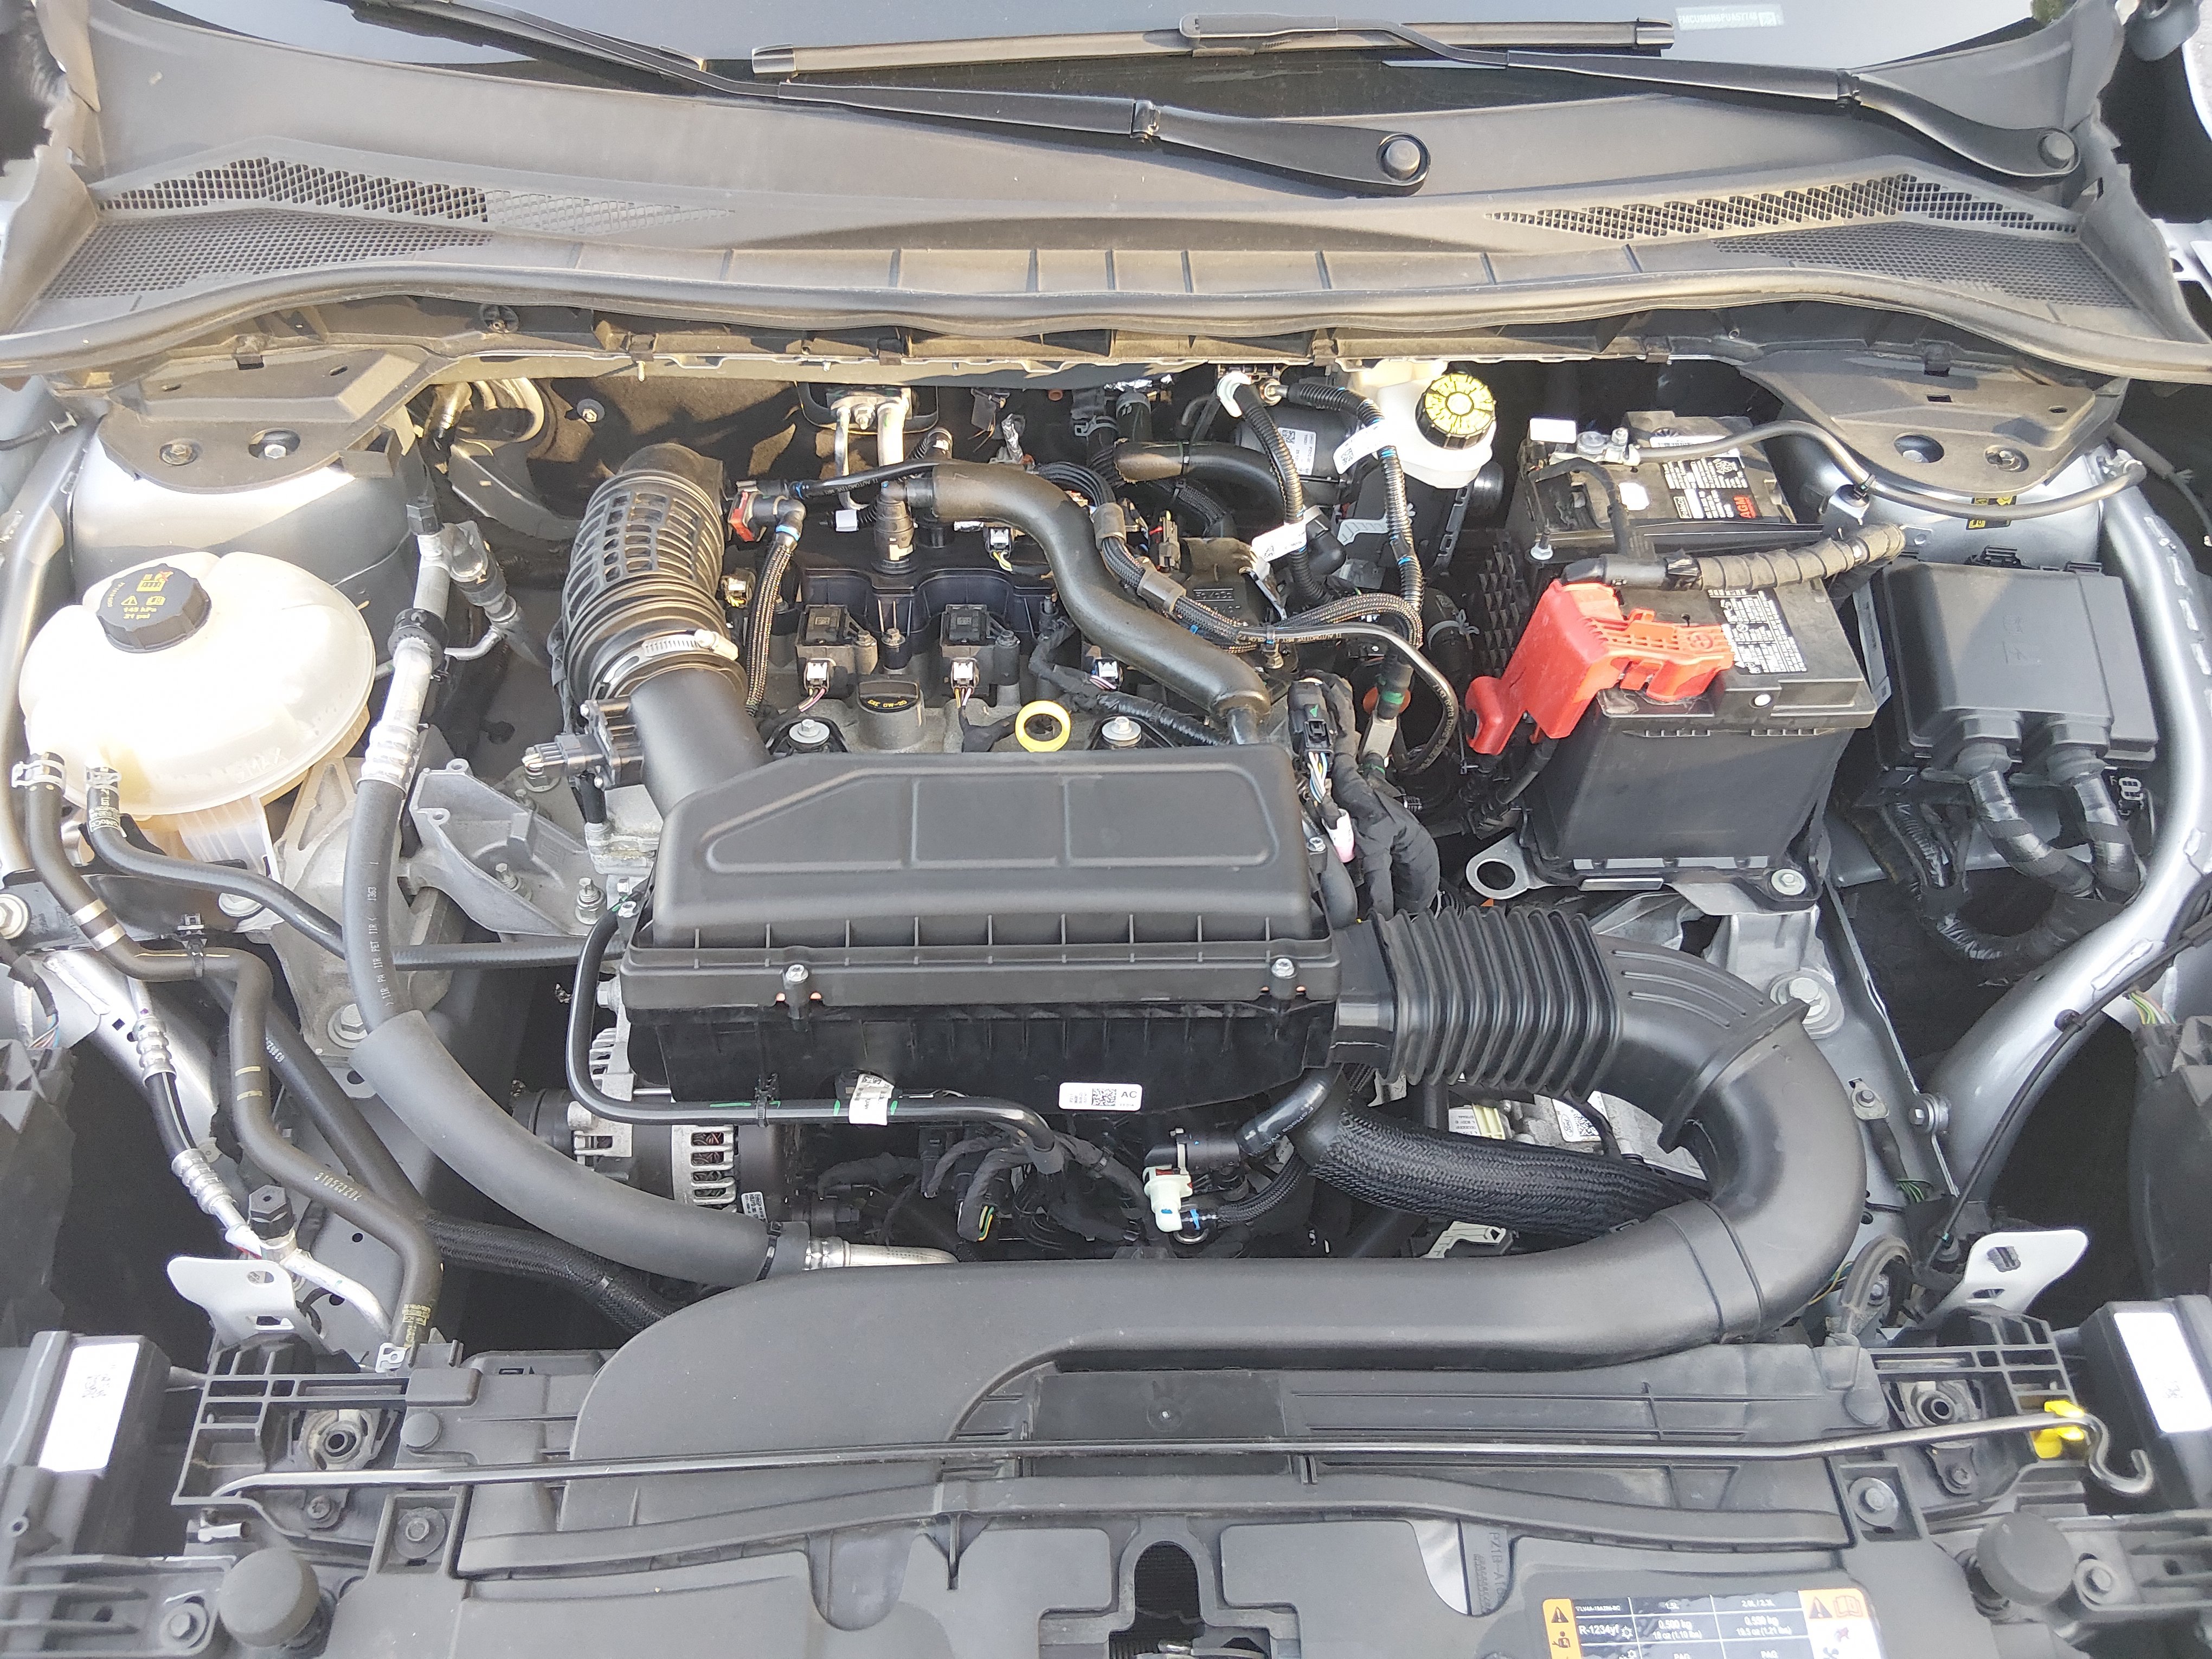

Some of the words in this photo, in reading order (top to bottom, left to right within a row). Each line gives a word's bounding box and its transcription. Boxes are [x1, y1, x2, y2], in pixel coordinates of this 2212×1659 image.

[1733, 496, 1750, 518] AGM
[882, 700, 908, 708] 0W-20
[1680, 1619, 1693, 1631] kg
[1767, 1616, 1779, 1627] kg
[1578, 1624, 1619, 1636] R-1234yf
